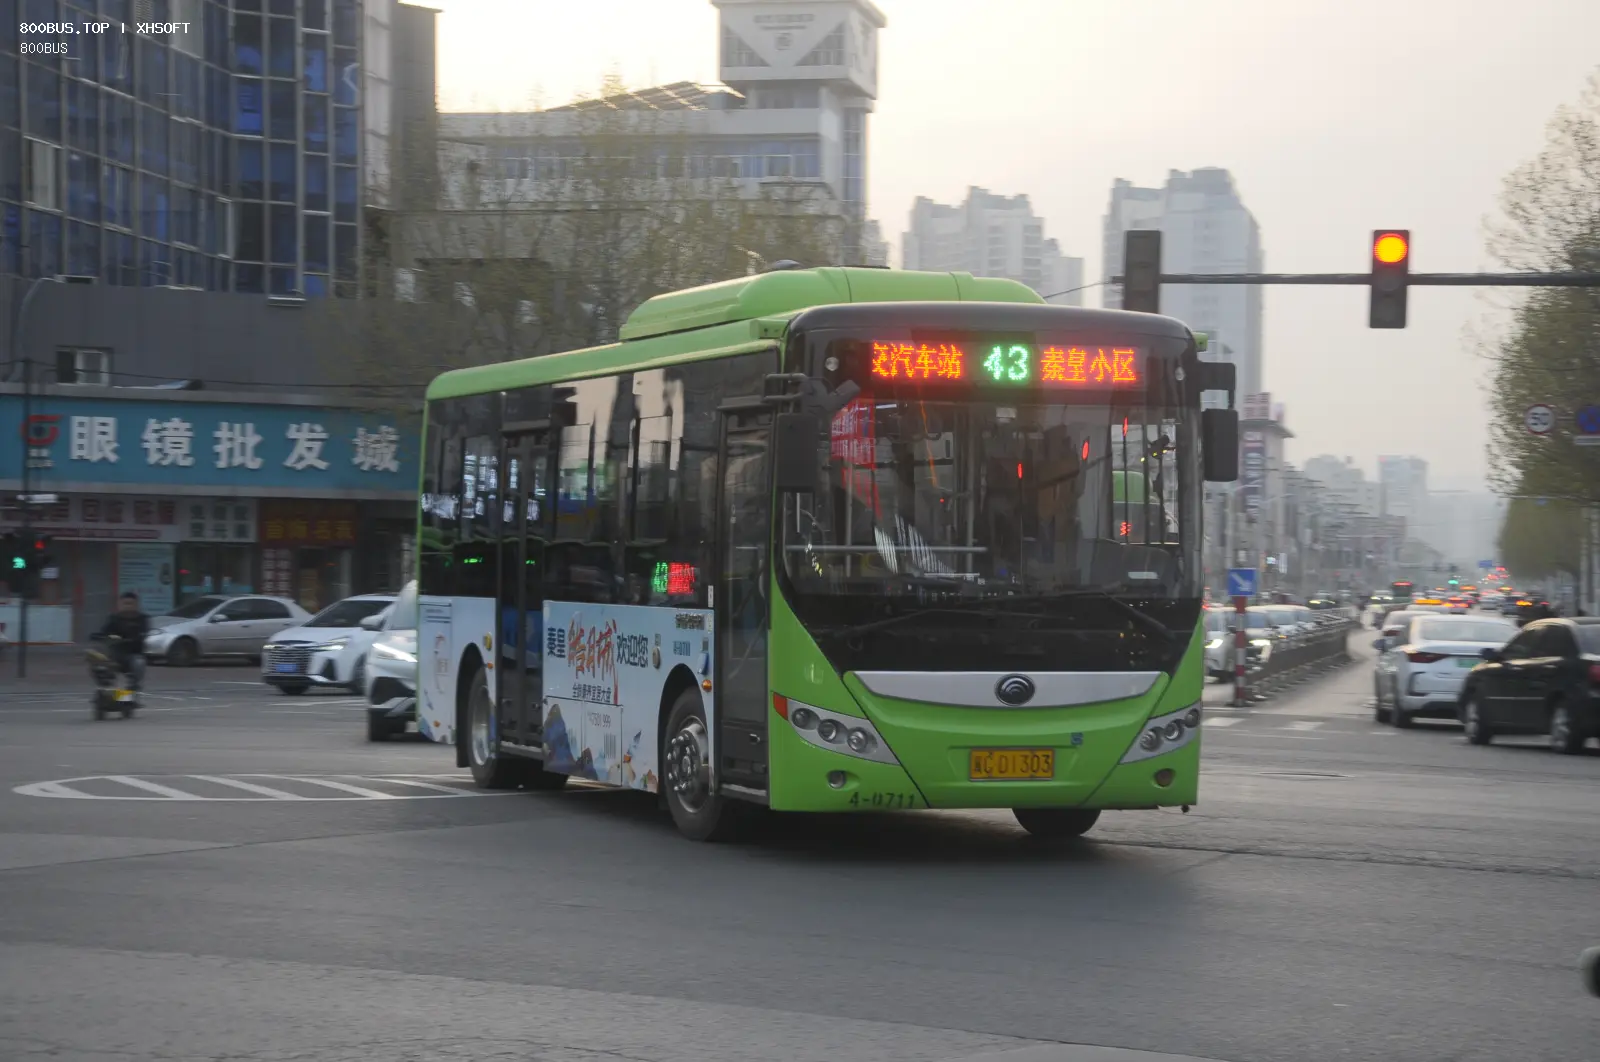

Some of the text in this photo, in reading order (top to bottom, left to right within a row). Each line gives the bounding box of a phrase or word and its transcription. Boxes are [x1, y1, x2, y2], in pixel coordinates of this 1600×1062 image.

[983, 345, 1029, 381] 43
[1041, 347, 1137, 382] 秦皇小区
[69, 414, 401, 473] 眼镜批发城
[616, 633, 649, 668] 欢迎您
